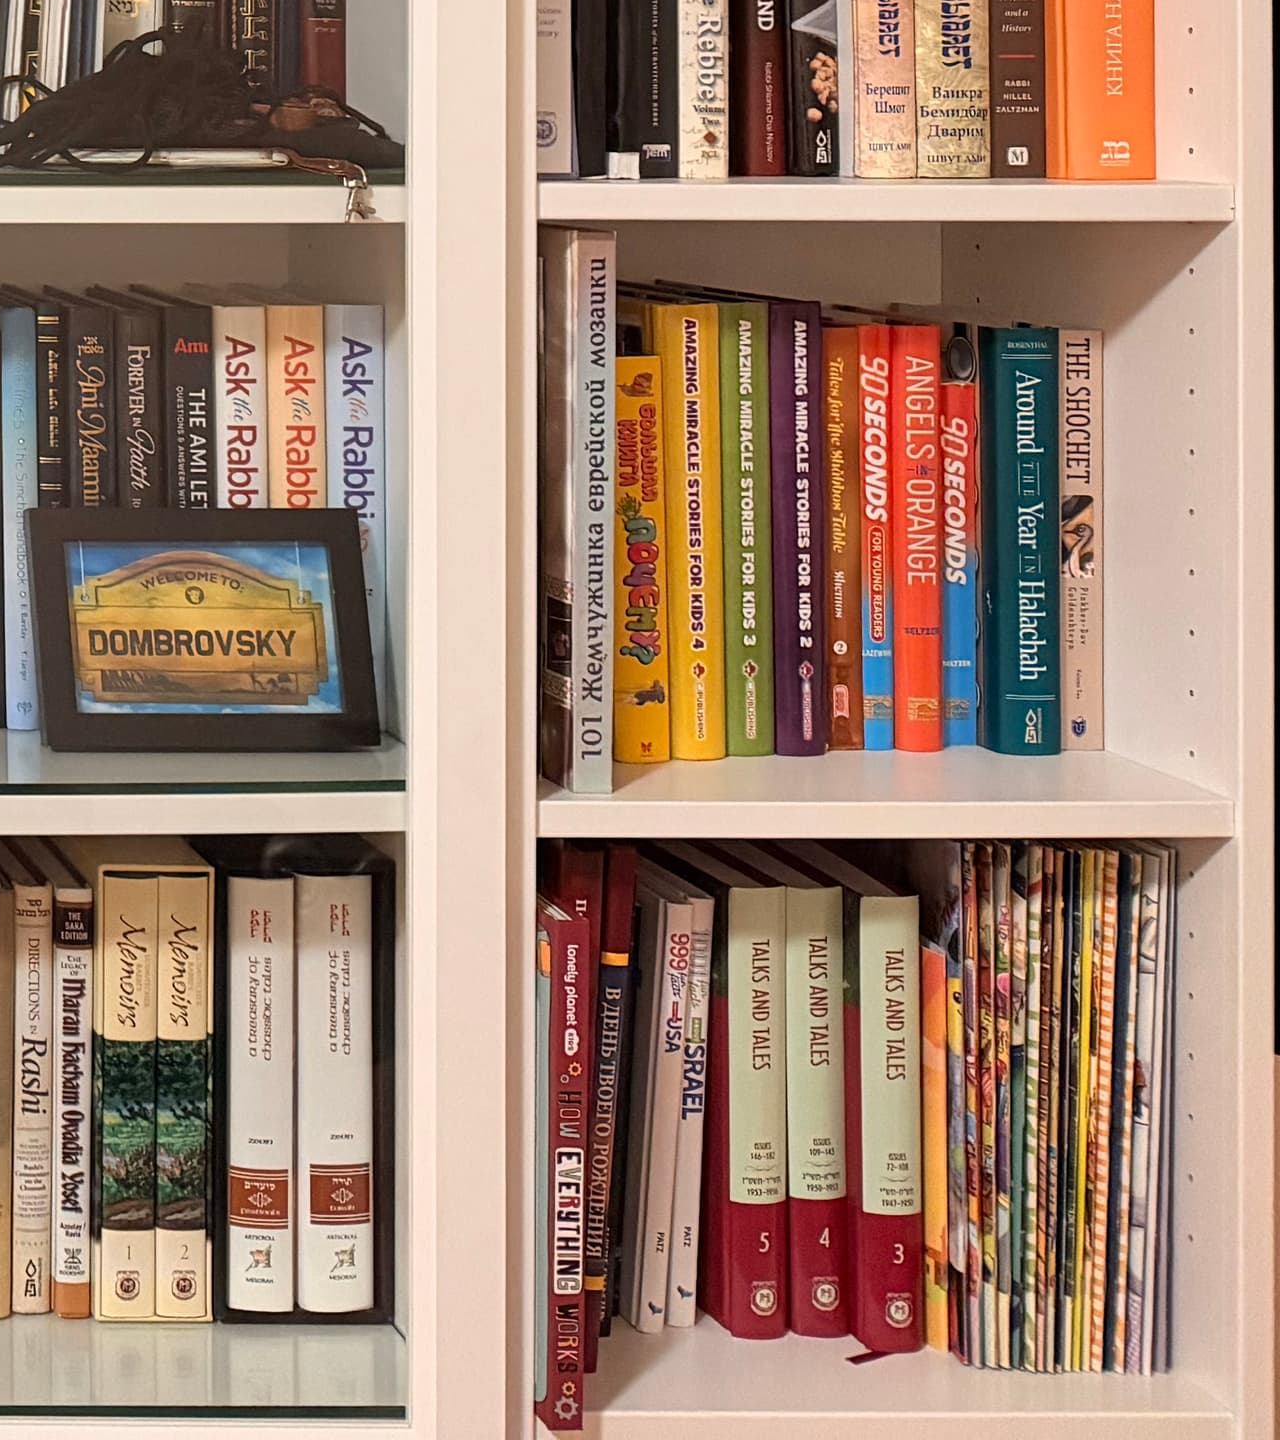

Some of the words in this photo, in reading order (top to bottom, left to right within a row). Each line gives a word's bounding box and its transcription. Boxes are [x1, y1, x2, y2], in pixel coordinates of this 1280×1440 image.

[699, 15, 723, 102] Rebbe
[1106, 31, 1123, 97] КНИГА
[589, 257, 606, 367] мозаики
[225, 336, 256, 389] Ask
[683, 319, 699, 393] AMAZING
[232, 394, 246, 423] the
[904, 356, 934, 458] ANGELS
[1015, 370, 1042, 454] Around
[589, 380, 606, 512] еврейской
[684, 400, 700, 472] MIRACLE
[226, 425, 258, 508] Rabb
[1022, 464, 1035, 498] THE
[686, 475, 702, 549] STORIES
[906, 479, 937, 586] ORANGE
[1017, 504, 1043, 550] Year
[140, 571, 217, 591] WELCOME
[688, 555, 702, 587] FOR
[580, 523, 605, 703] Жемчужинка
[690, 593, 704, 631] KIDS
[1020, 580, 1046, 681] Halachah
[89, 630, 296, 658] DOMBROVSKY
[691, 636, 704, 650] 4
[580, 716, 603, 761] 101
[119, 914, 146, 1029] Memoirs
[565, 944, 579, 981] lonely
[752, 939, 769, 980] TALKS
[565, 985, 579, 1027] planet
[754, 984, 770, 1020] AND
[20, 1035, 48, 1115] Rashi
[754, 1026, 772, 1072] TALES
[759, 1233, 769, 1253] 5
